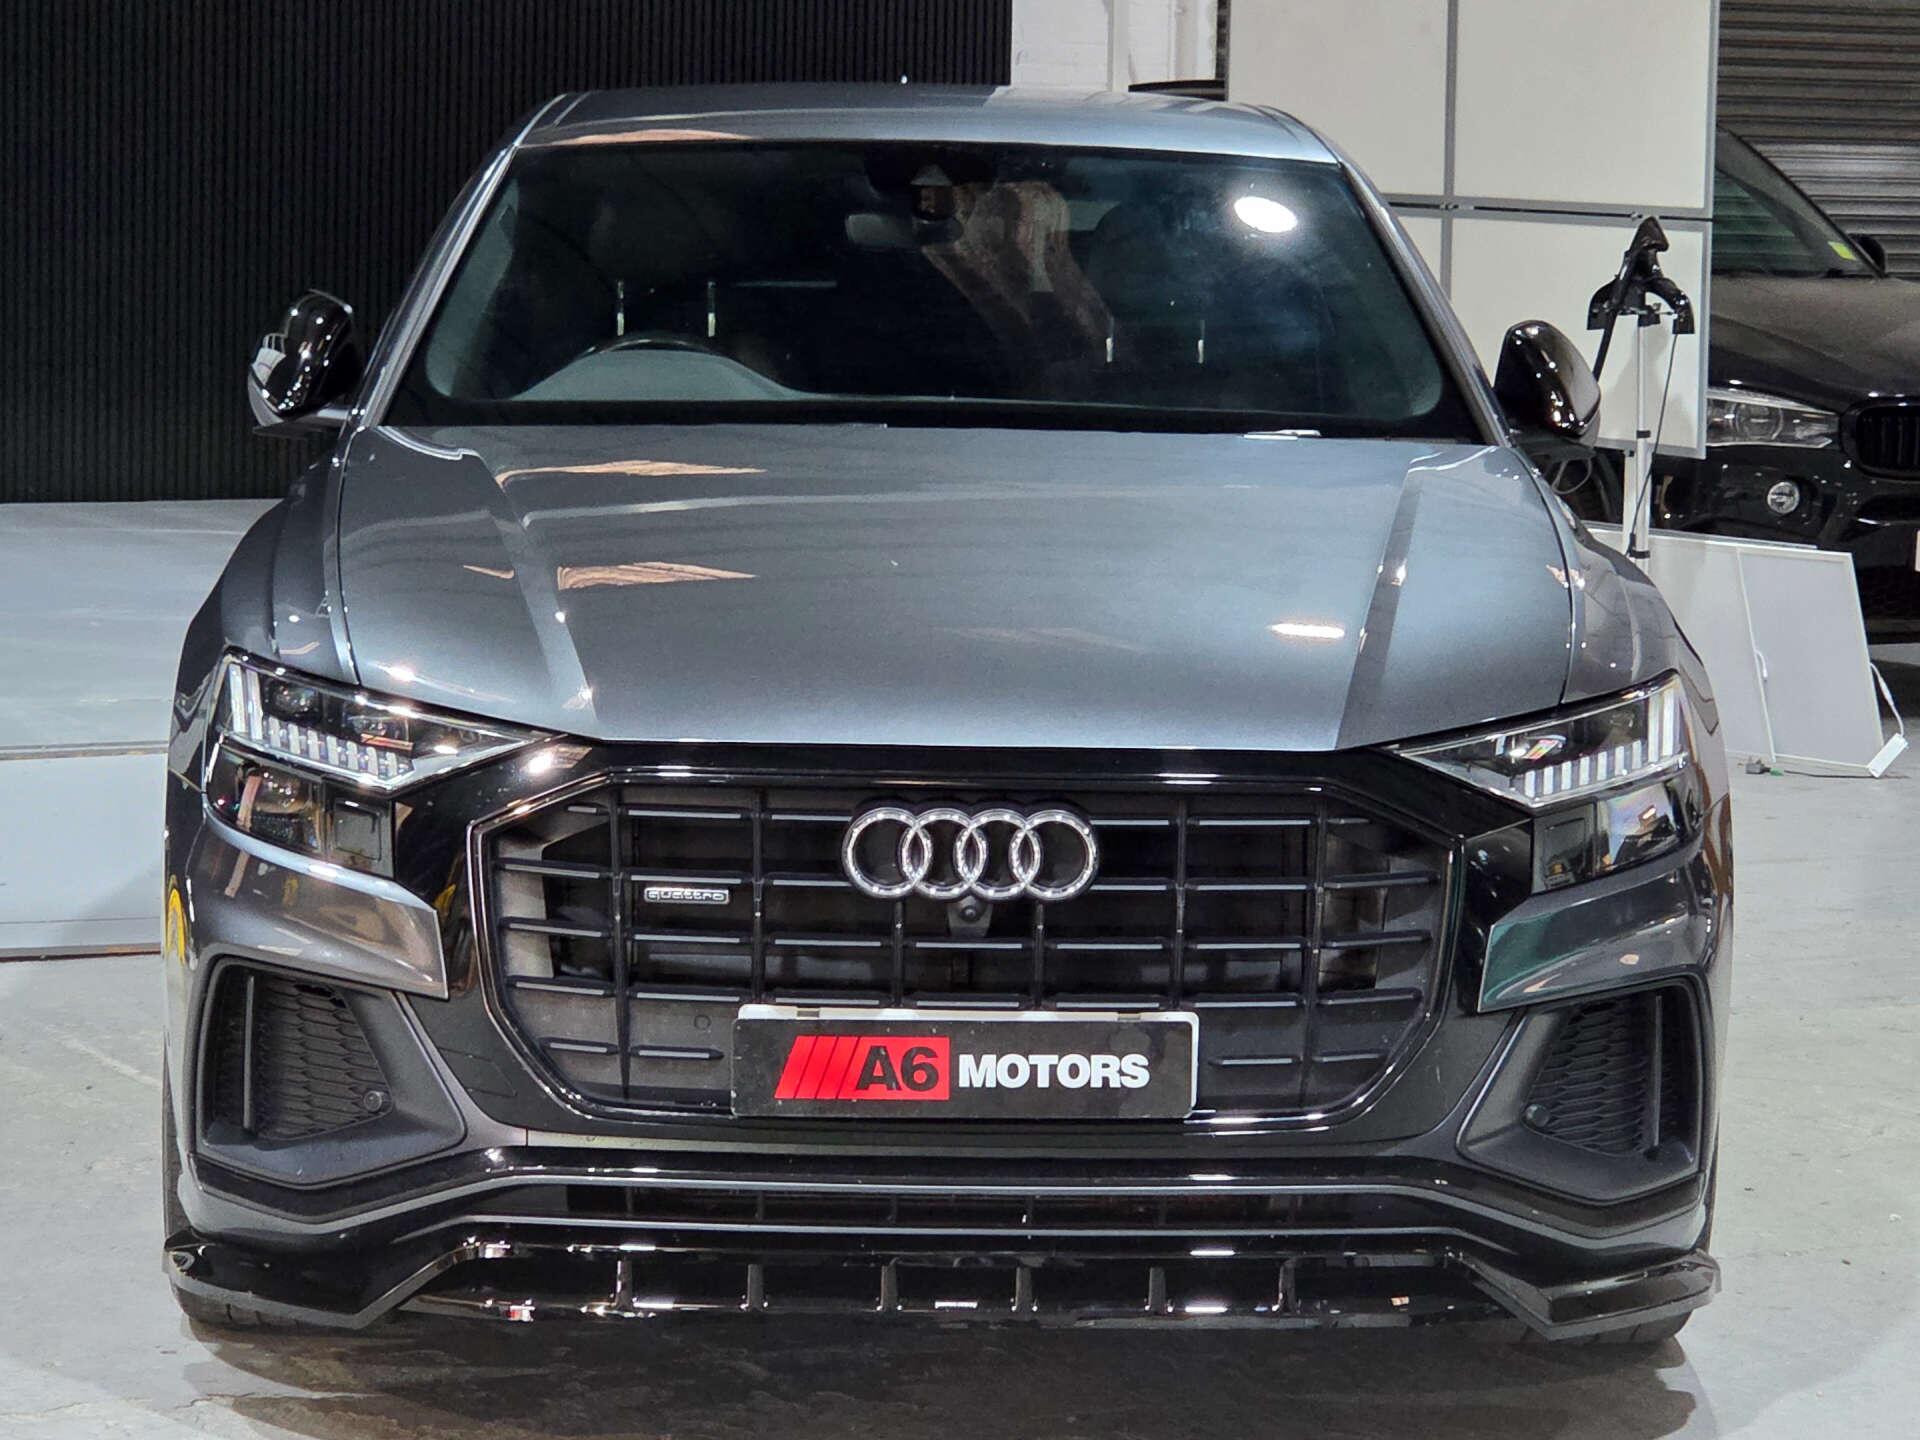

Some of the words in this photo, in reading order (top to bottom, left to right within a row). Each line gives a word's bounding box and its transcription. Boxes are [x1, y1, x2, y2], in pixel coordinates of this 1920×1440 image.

[647, 889, 725, 901] quattro
[855, 1046, 939, 1092] A6
[958, 1053, 1150, 1089] MOTORS
